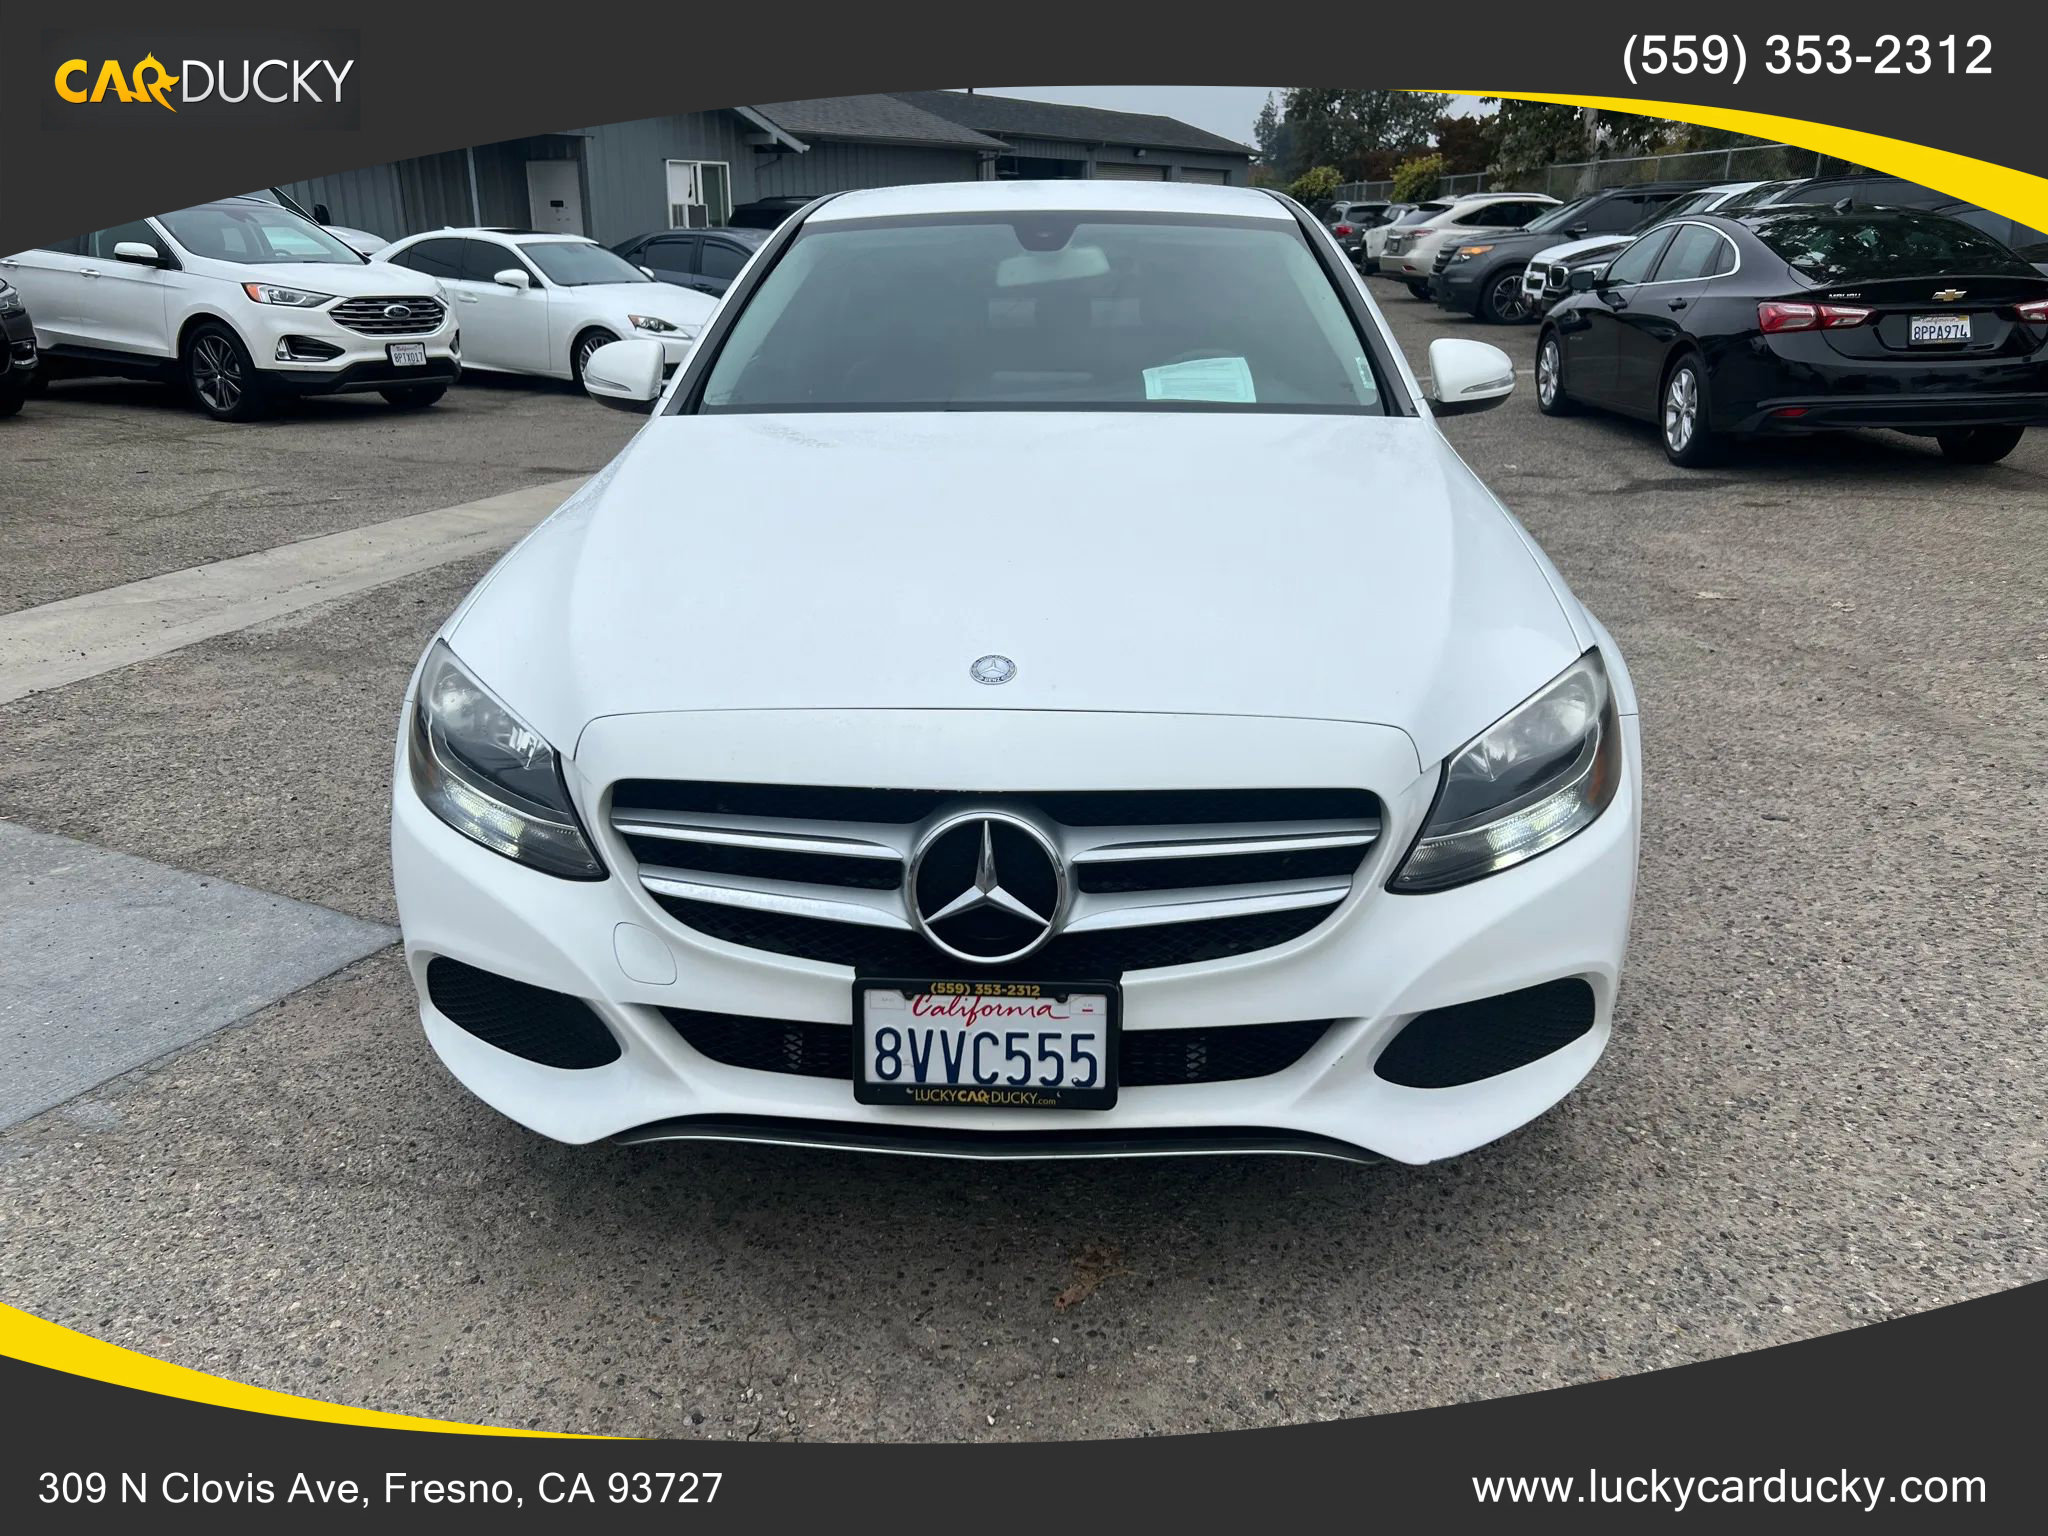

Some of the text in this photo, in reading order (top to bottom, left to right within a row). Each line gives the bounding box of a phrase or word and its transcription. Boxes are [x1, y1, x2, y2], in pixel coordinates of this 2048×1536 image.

[1913, 325, 1968, 340] 8PPA974
[930, 982, 1041, 997] (559) 353-2312
[911, 993, 1070, 1027] California
[875, 1026, 1098, 1088] 8VVC555
